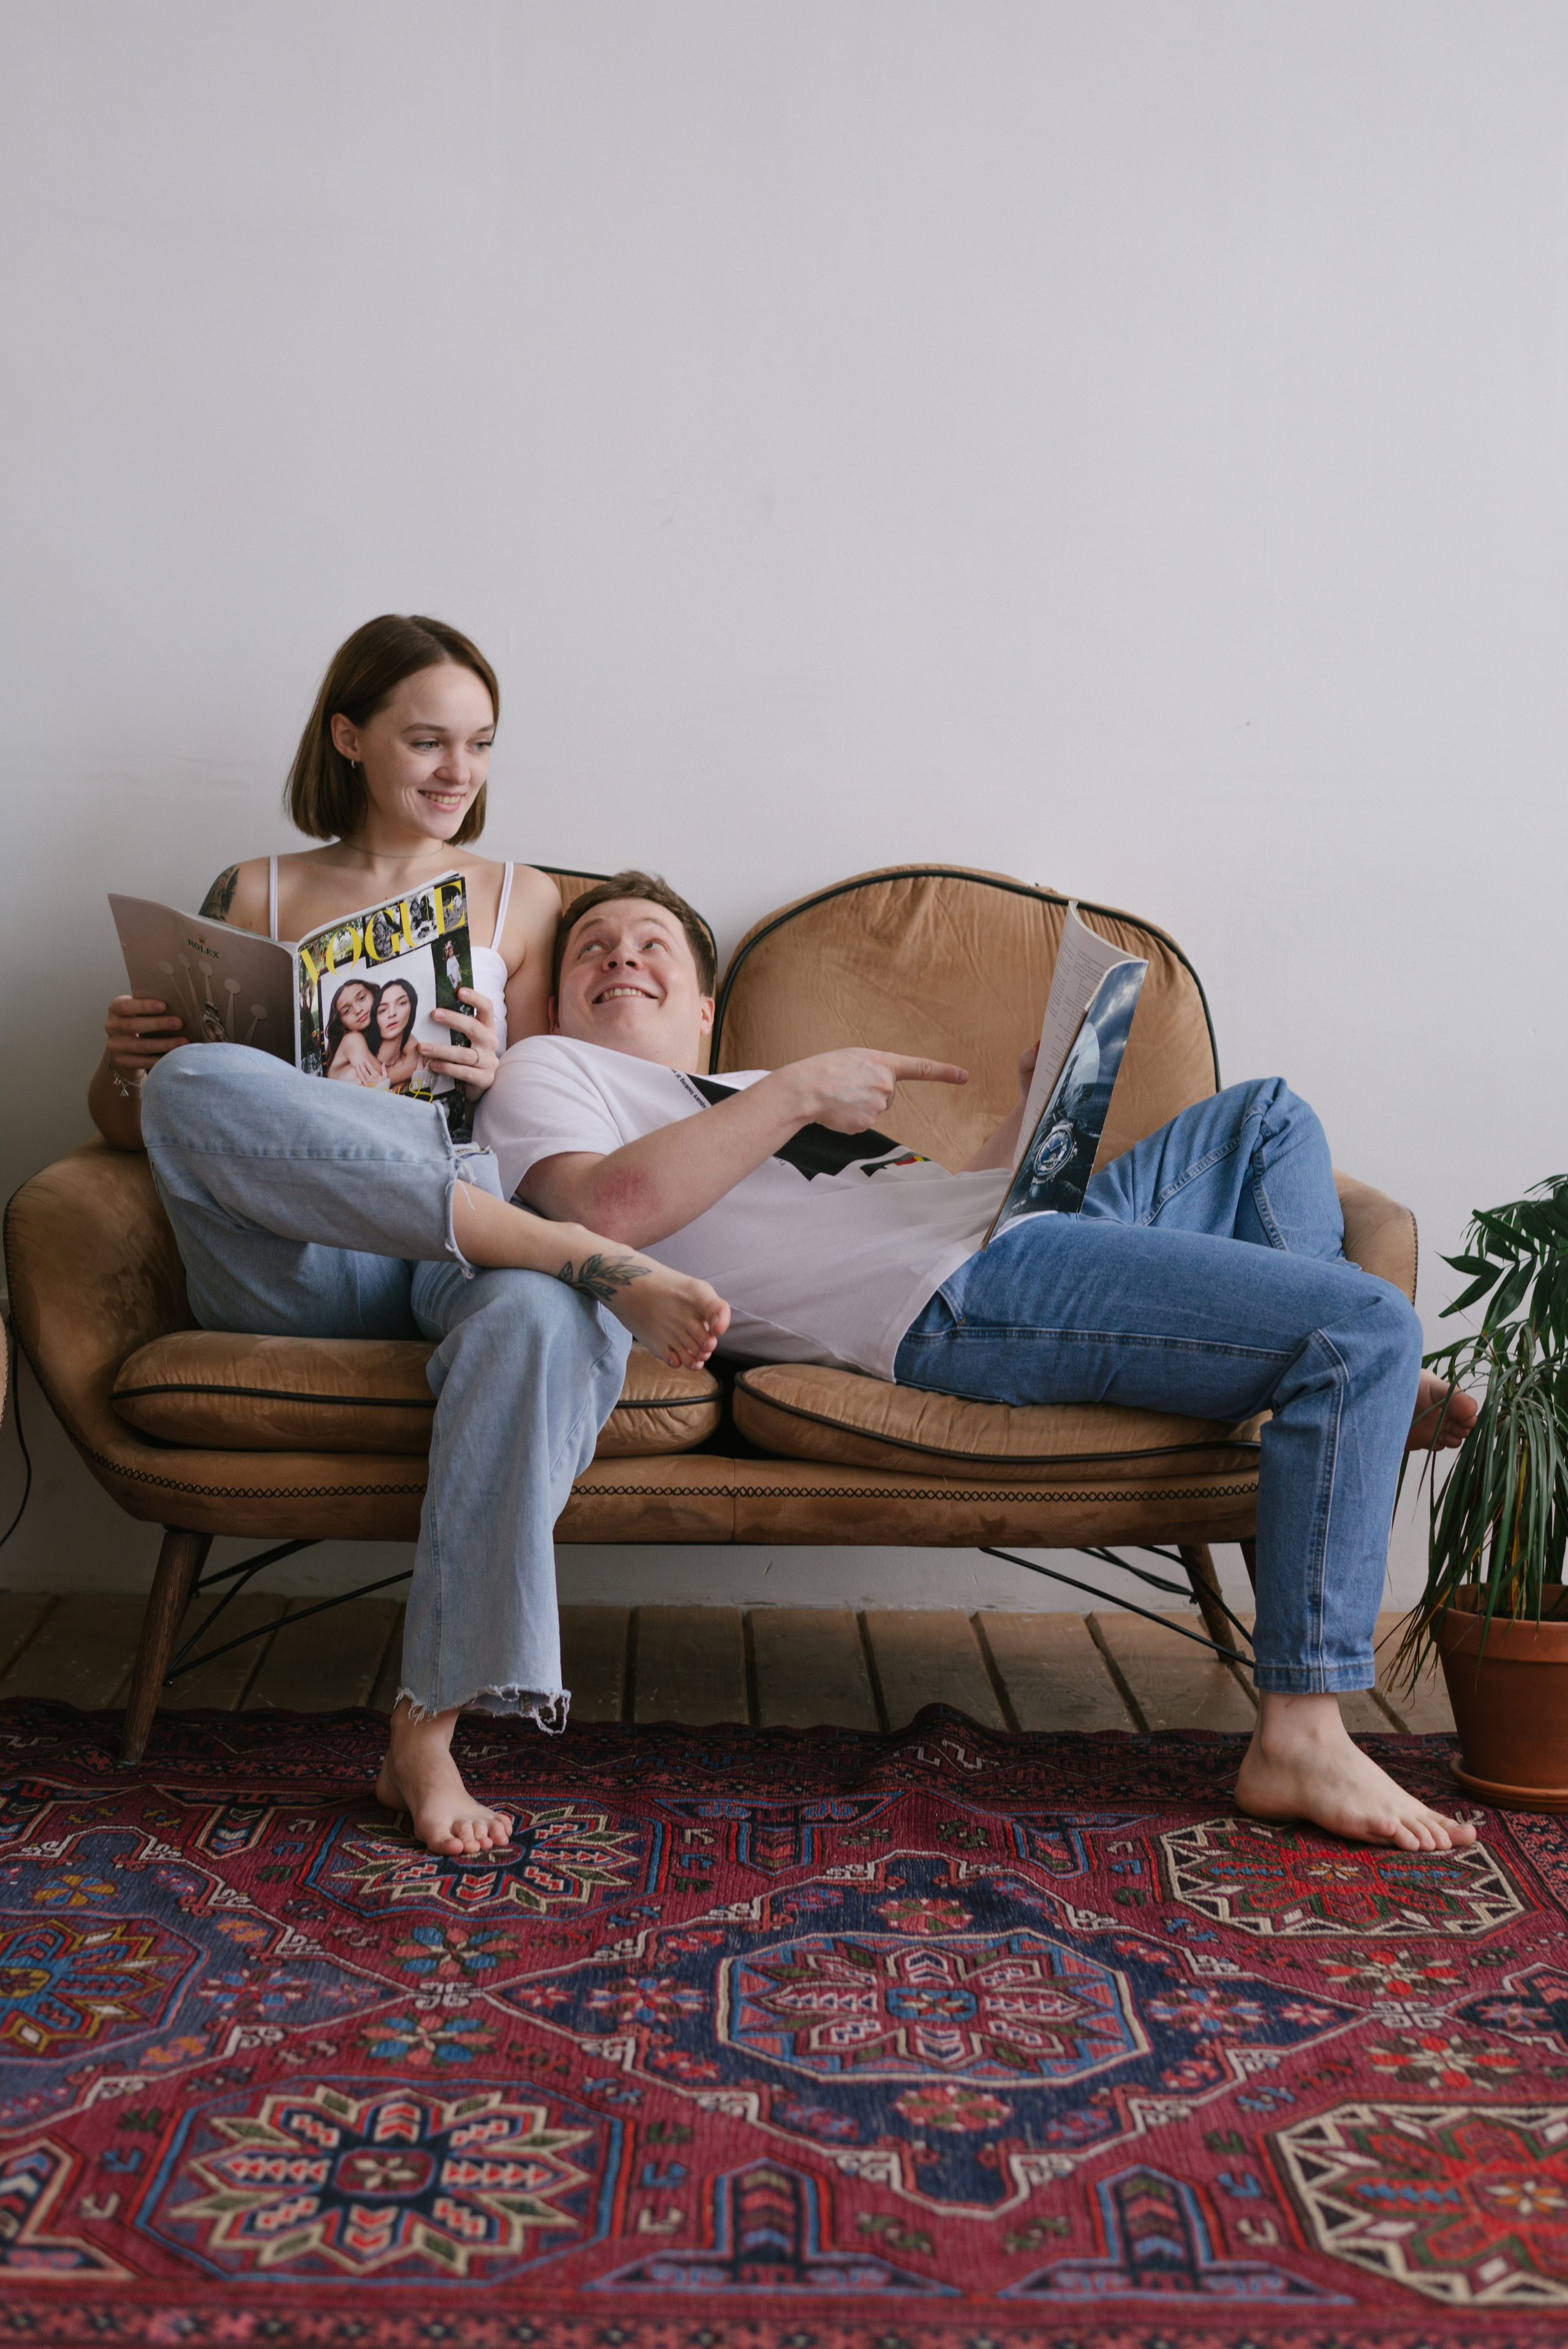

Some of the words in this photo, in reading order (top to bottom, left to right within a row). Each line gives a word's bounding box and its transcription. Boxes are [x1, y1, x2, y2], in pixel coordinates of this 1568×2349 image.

[300, 880, 466, 987] VOGUE
[187, 938, 219, 959] ROLEX
[679, 1078, 695, 1095] looking
[693, 1094, 707, 1108] square
